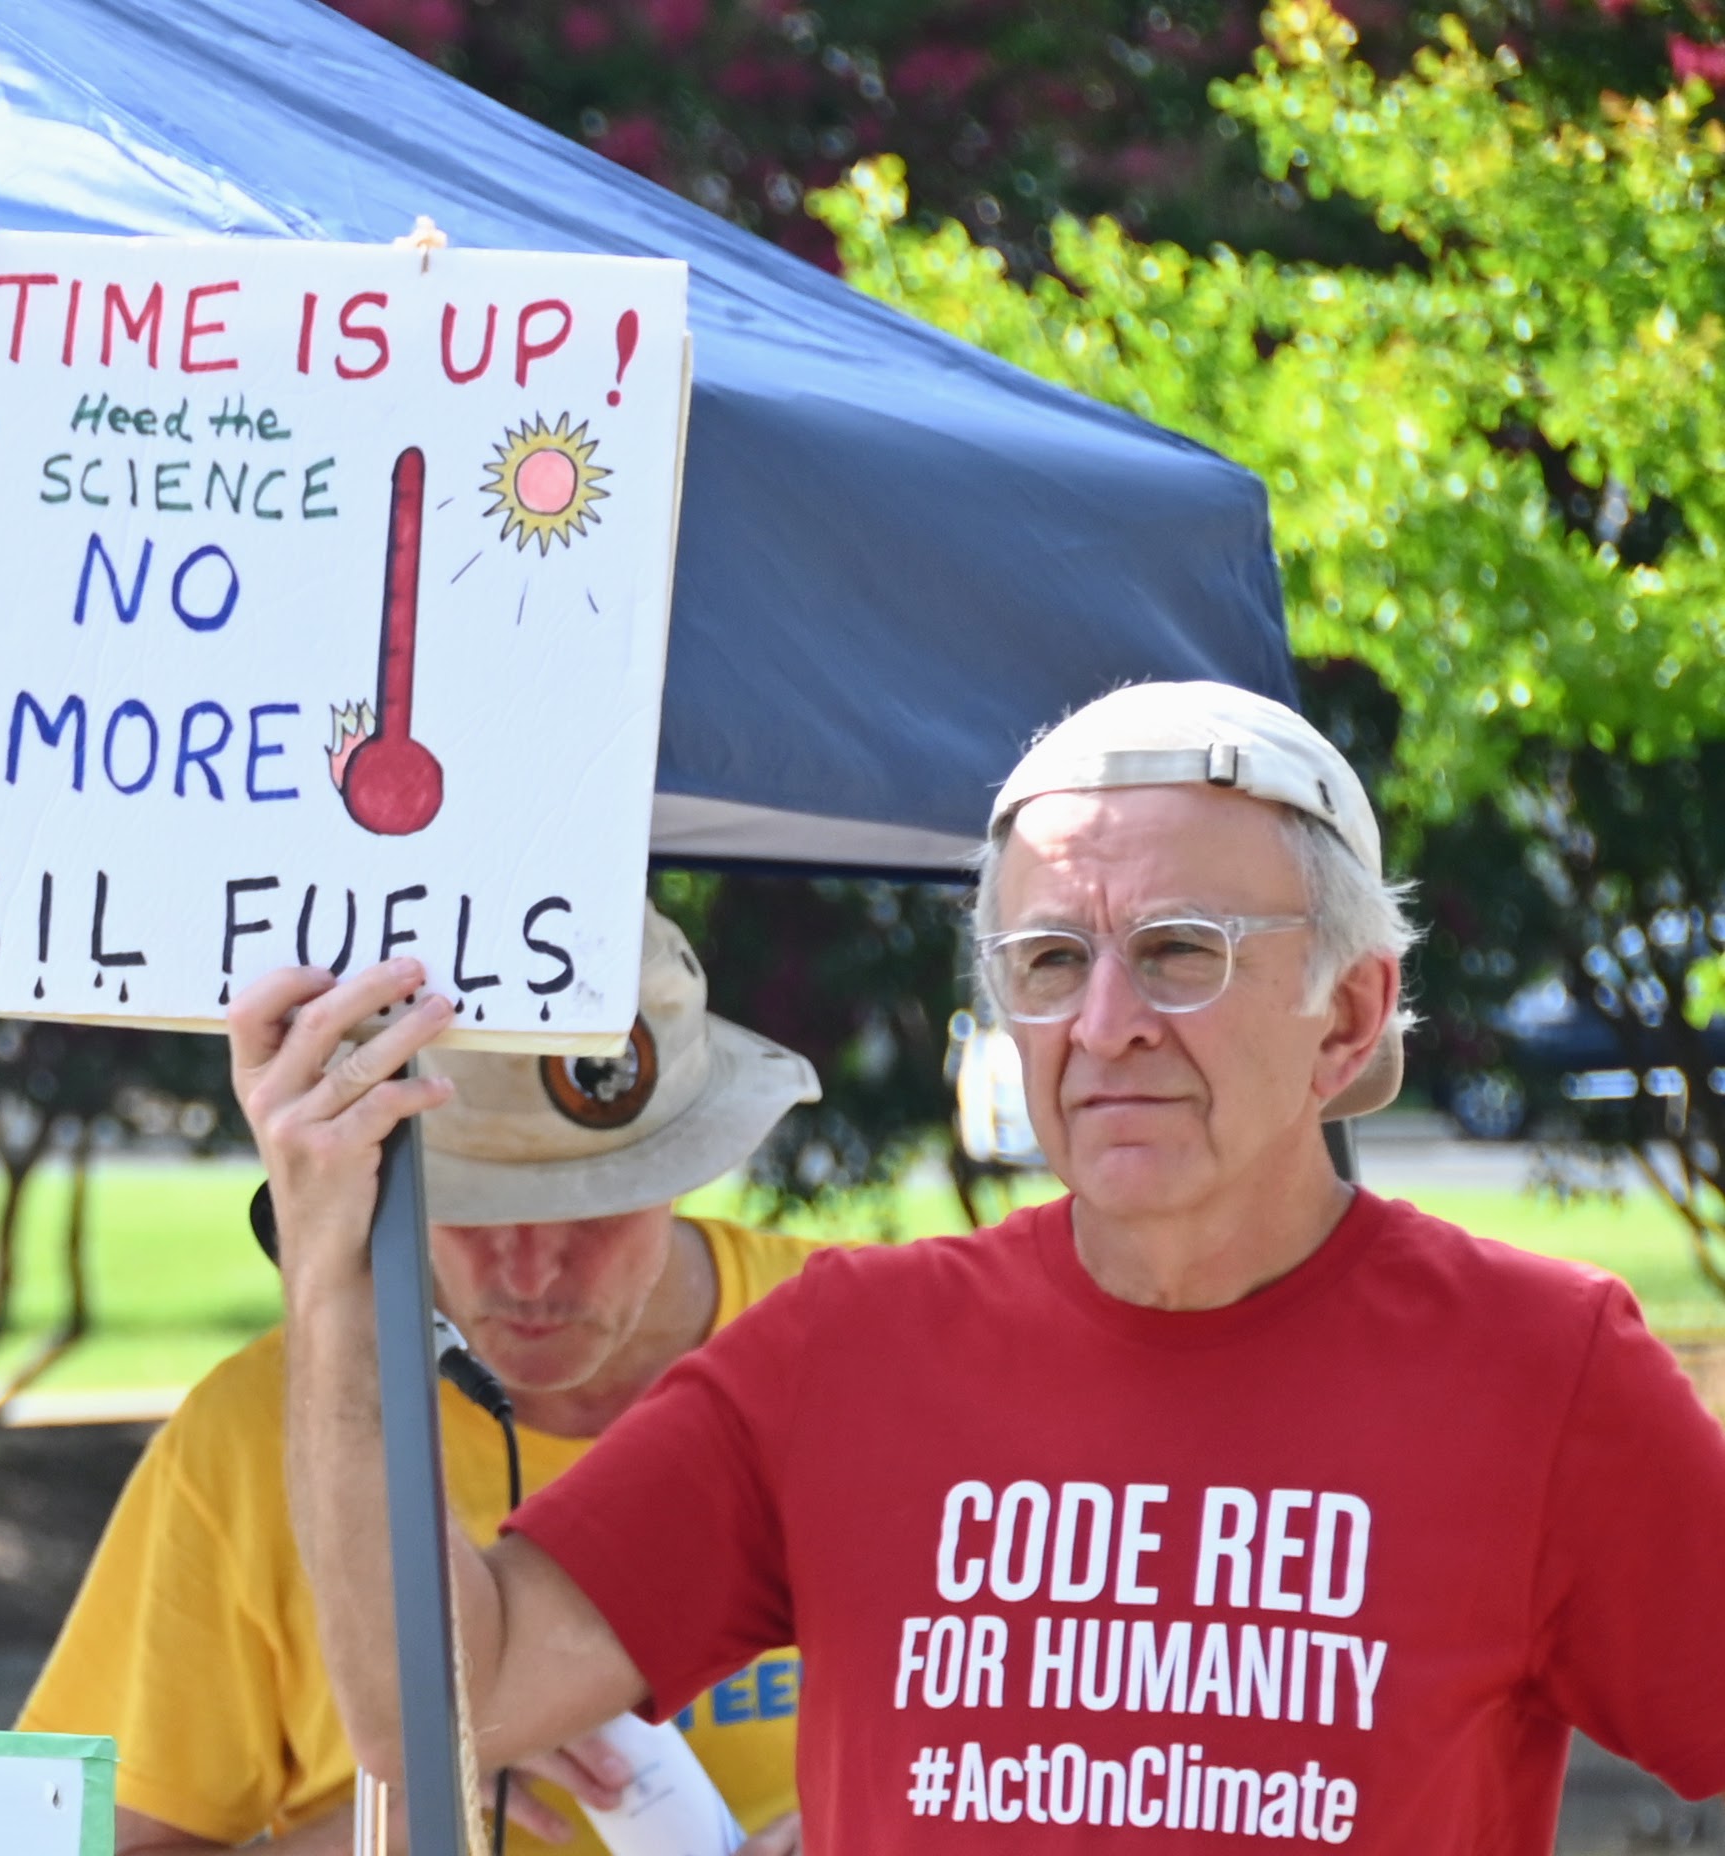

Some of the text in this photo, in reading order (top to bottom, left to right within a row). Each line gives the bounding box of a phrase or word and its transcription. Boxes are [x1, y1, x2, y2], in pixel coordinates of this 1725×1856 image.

[297, 291, 389, 381] IS
[70, 393, 293, 443] Heed the
[39, 453, 339, 521] SCIENCE
[72, 533, 241, 633] NO
[4, 691, 301, 803] MORE
[221, 876, 575, 994] FUELS
[936, 1479, 1373, 1619] CODE RED
[894, 1614, 1389, 1731] FOR HUMANITY
[906, 1741, 1358, 1845] #ActOnClimate
